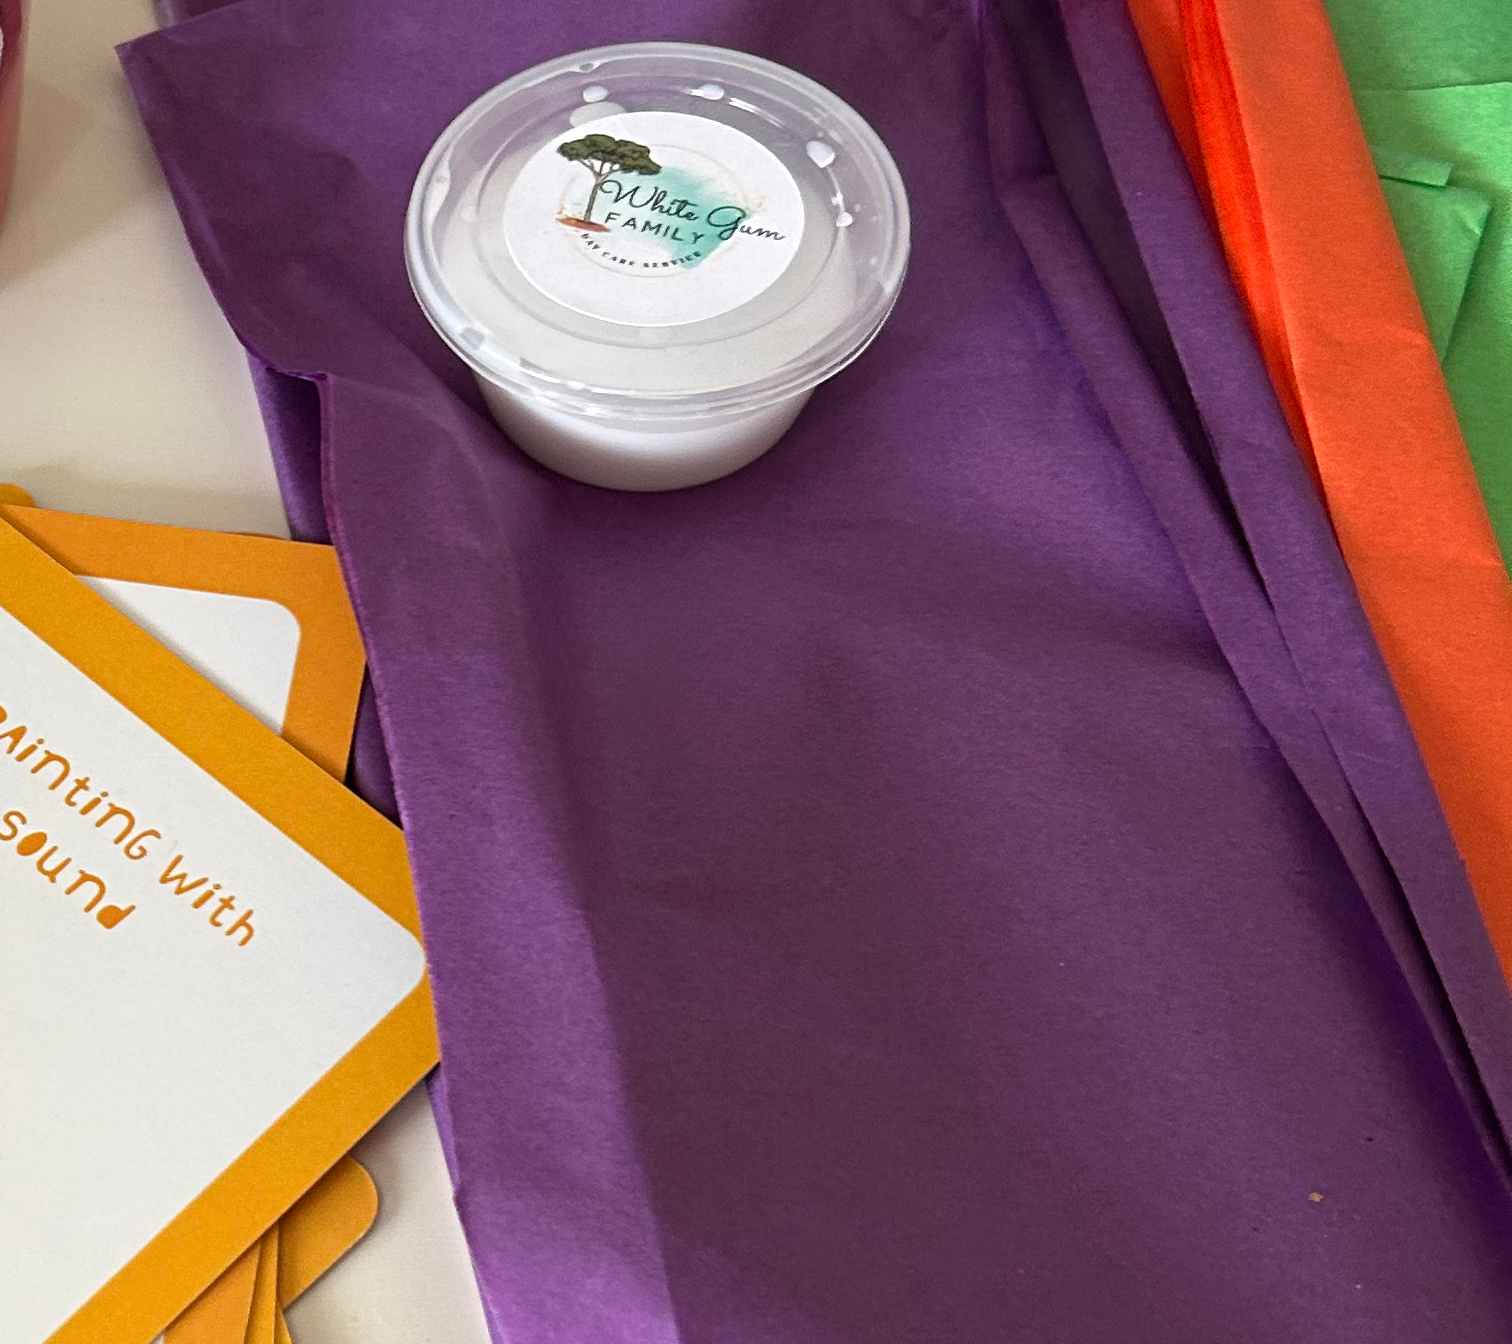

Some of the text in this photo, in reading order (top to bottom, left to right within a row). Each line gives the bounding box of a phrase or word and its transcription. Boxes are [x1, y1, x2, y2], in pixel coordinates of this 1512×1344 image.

[599, 179, 785, 241] White Gum
[604, 212, 706, 244] FAMILY
